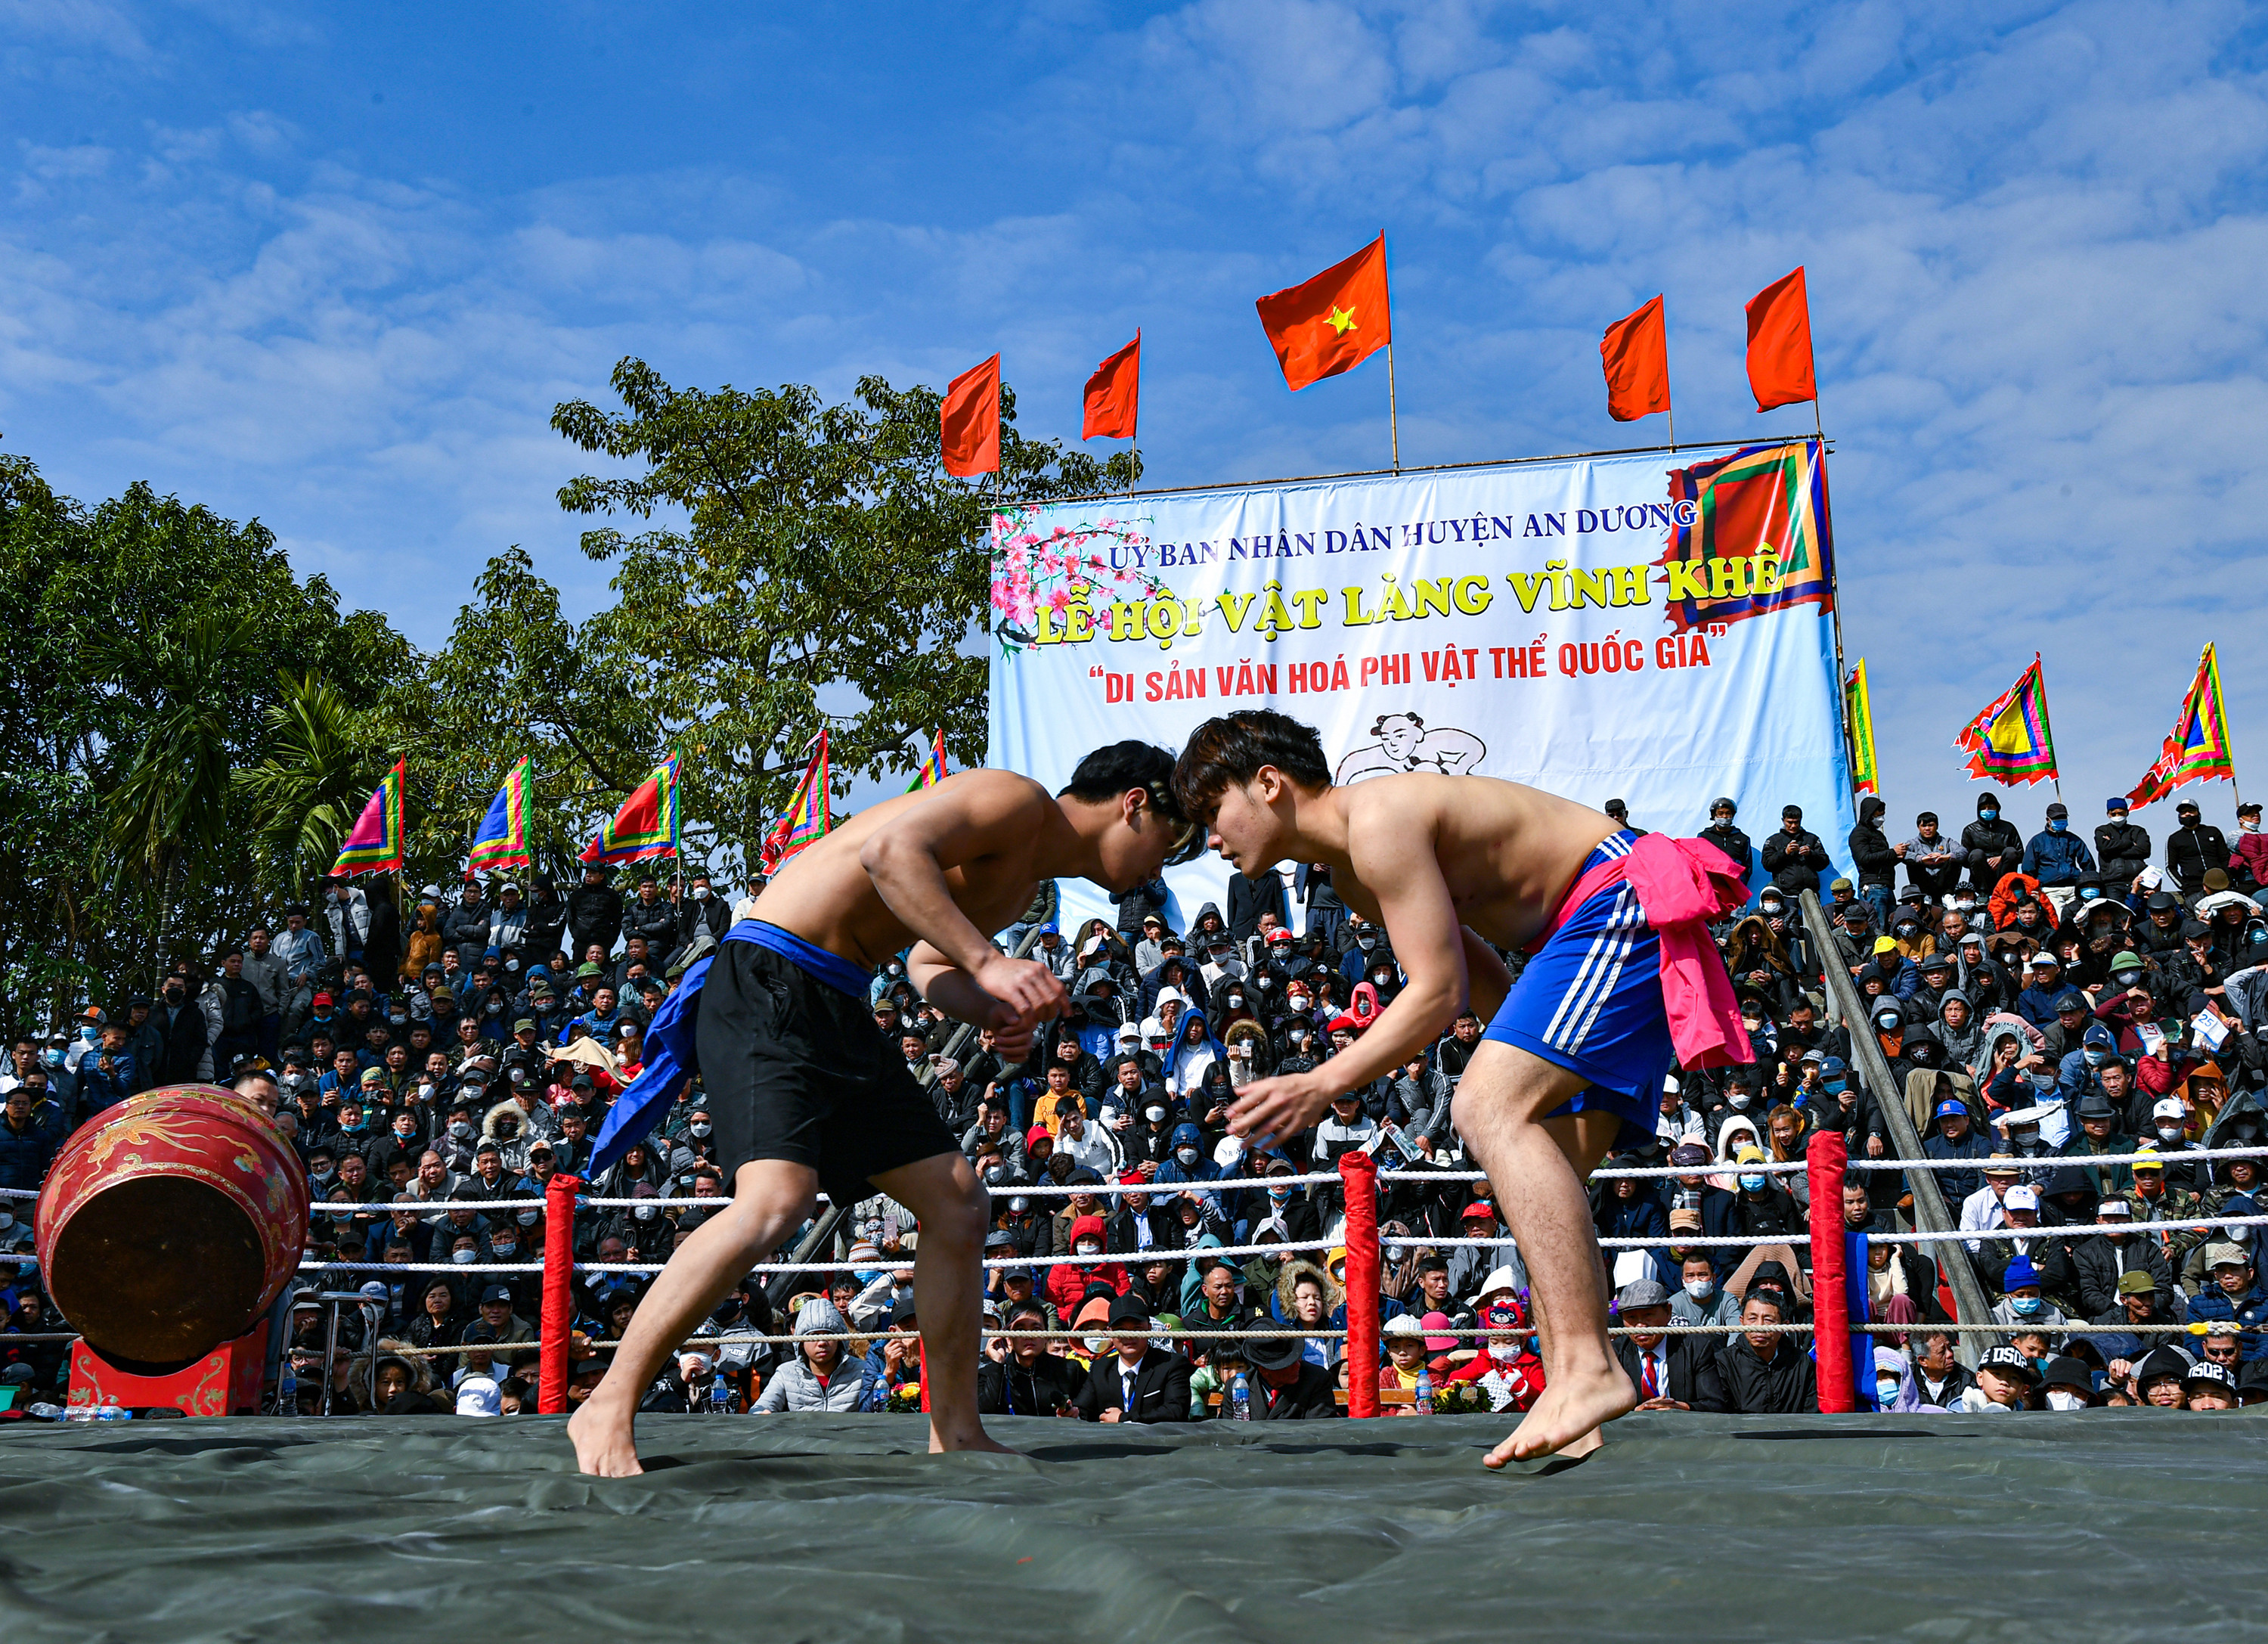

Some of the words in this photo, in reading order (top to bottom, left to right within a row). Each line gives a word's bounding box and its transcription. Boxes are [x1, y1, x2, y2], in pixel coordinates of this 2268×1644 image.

[1160, 540, 1218, 566] BAN
[1228, 528, 1315, 560] NHÂN
[1325, 522, 1393, 554] DÂN
[1402, 512, 1513, 547] HUYỆN
[1523, 512, 1566, 538] AN
[1576, 501, 1697, 533] DƯƠNG
[1035, 585, 1095, 644] LỄ
[1109, 588, 1202, 650] HỘI
[1216, 579, 1328, 641] VẬT
[1342, 572, 1493, 626] LÀNG
[1507, 558, 1650, 613] VĨNH
[1665, 542, 1784, 602] KHÊ
[1145, 660, 1206, 702] SẢN
[1216, 658, 1277, 696] VĂN
[1289, 654, 1350, 693] HOÁ
[1361, 648, 1411, 687] PHI
[1421, 643, 1479, 687] VẬT
[1489, 633, 1548, 678] THỂ
[1558, 629, 1644, 677] QUỐC
[2144, 1024, 2159, 1036] 27
[2198, 1013, 2214, 1027] 25
